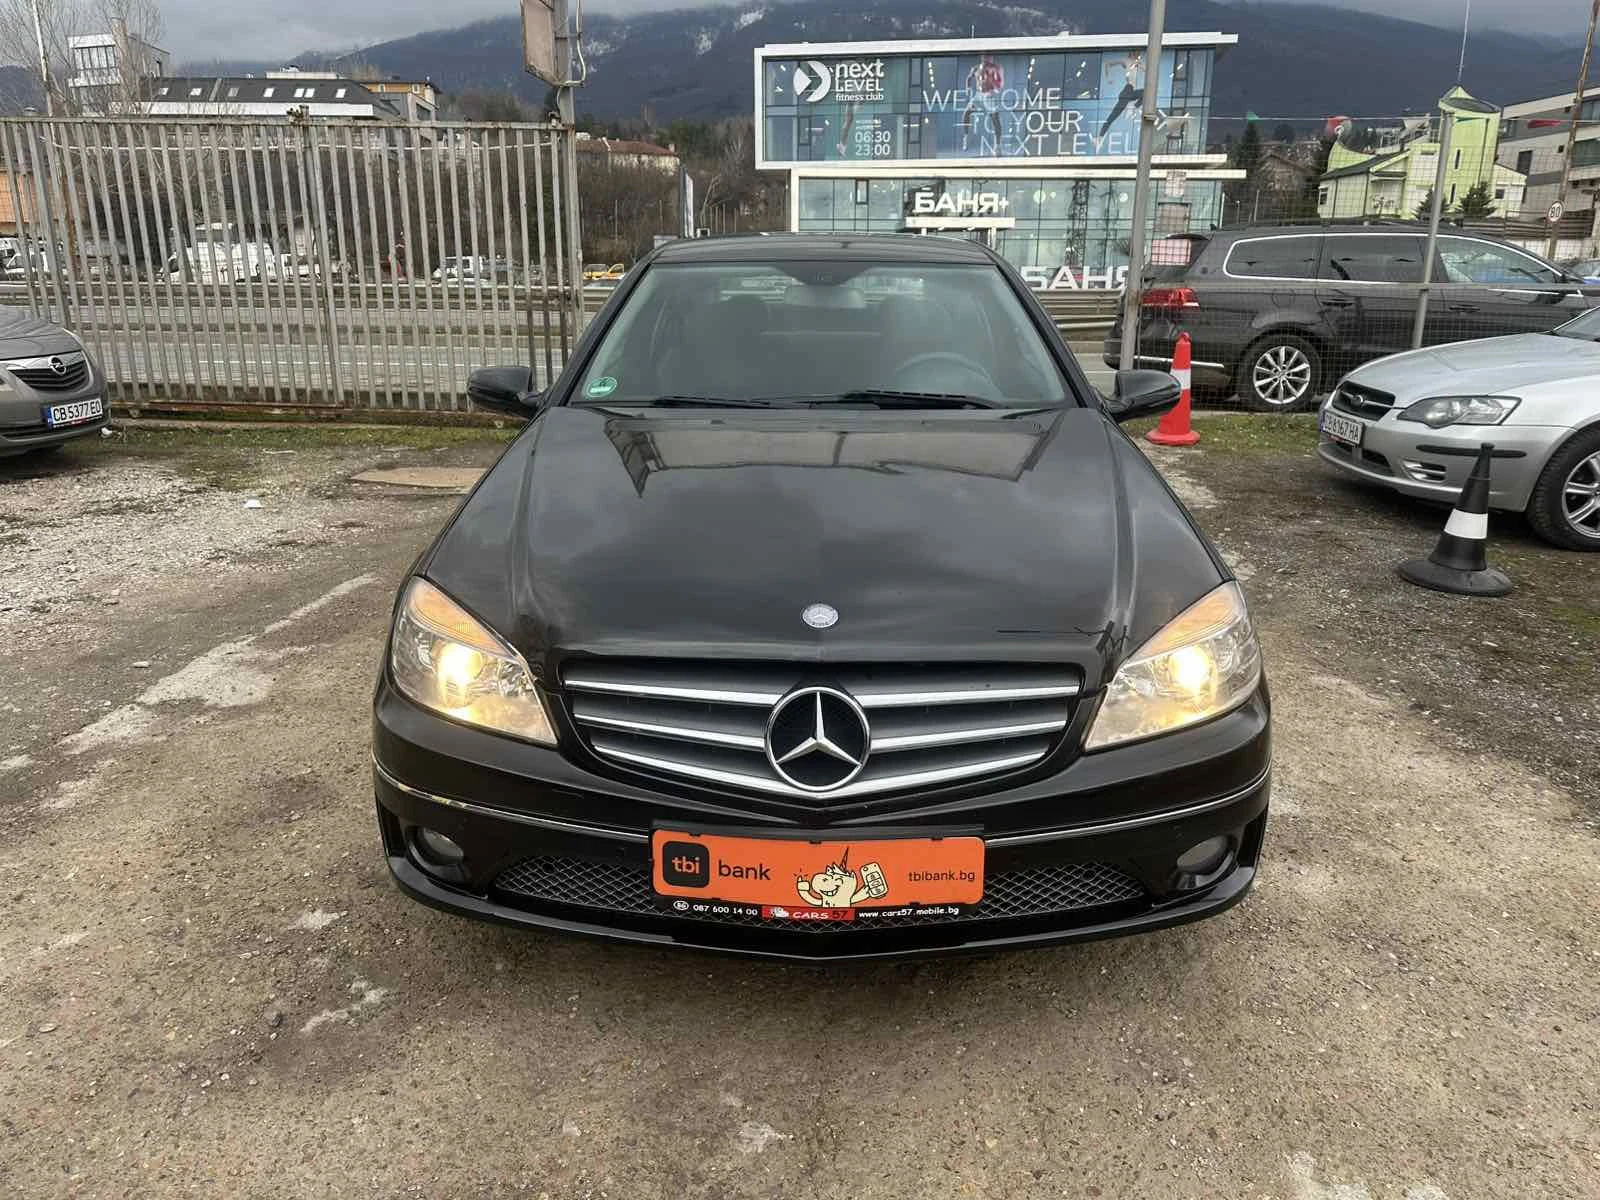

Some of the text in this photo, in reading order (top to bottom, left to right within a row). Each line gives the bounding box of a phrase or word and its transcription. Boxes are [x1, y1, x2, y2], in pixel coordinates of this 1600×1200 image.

[835, 59, 884, 78] next
[835, 78, 884, 92] LEVEL
[836, 93, 884, 101] fitness club
[923, 88, 1061, 112] WELCOME
[1013, 111, 1081, 133] YOUR
[855, 131, 891, 143] 06:30
[855, 144, 890, 156] 23:00
[980, 132, 1137, 156] NEXT LEVEL
[672, 856, 771, 880] tbi bank
[908, 870, 976, 883] tbibank.bg
[692, 904, 710, 912] 087
[712, 906, 730, 914] 600
[793, 908, 849, 920] CARS 57
